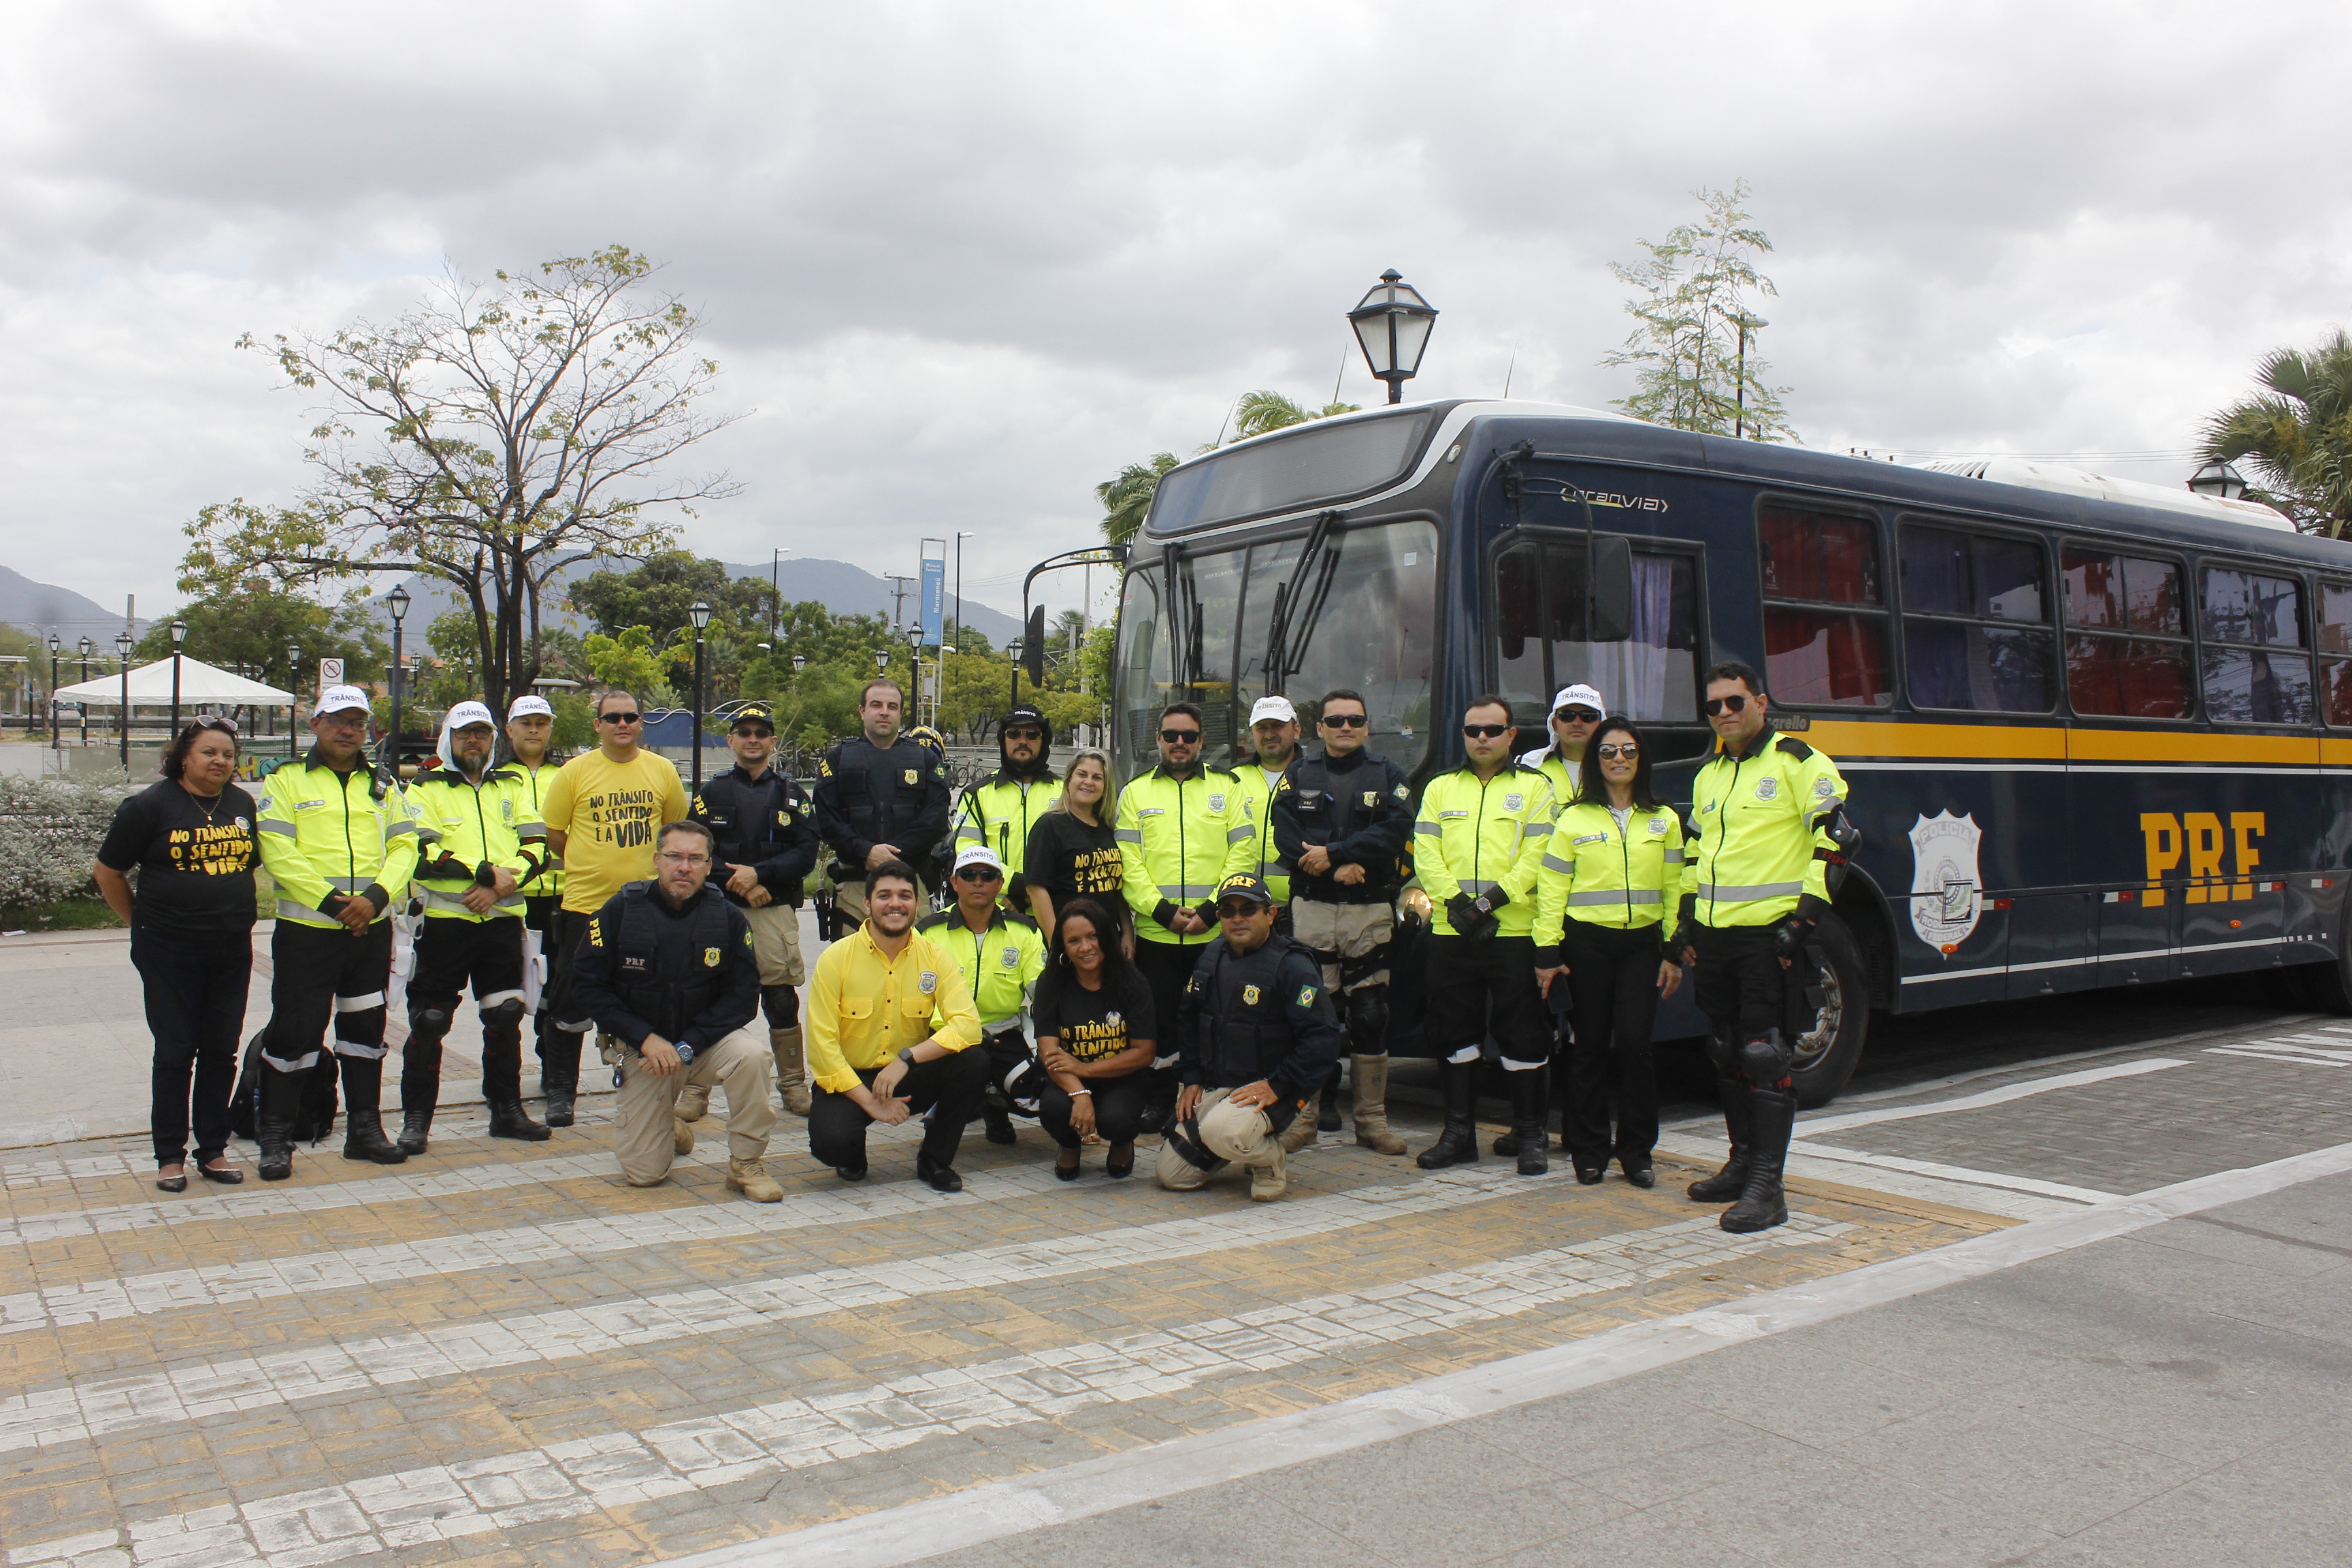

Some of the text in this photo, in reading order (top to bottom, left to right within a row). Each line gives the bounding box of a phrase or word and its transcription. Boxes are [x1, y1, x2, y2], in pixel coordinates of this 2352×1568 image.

[933, 577, 941, 613] Maracanaú
[331, 693, 365, 705] TRÂNSITO
[1562, 691, 1595, 702] TRÂNSITO
[457, 708, 489, 720] TRÂNSITO
[521, 703, 551, 713] TRÂNSITO
[738, 708, 766, 719] PRF
[1014, 709, 1036, 717] TRÂNSITO
[1767, 715, 1807, 730] arello
[918, 738, 932, 747] RF
[819, 758, 833, 777] PRF
[590, 788, 655, 808] NO TRÂNSITO,
[693, 794, 708, 815] PRF
[592, 806, 653, 822] O SENTIDO
[169, 830, 190, 843] NO
[596, 818, 653, 848] É A VIDA
[171, 839, 253, 860] O SENTIDO
[962, 851, 994, 862] TRÂNSITO
[1075, 853, 1090, 868] NO
[1822, 849, 1847, 866] Tige
[2140, 812, 2266, 907] PRF
[1075, 871, 1083, 881] O
[1221, 875, 1257, 891] PRF
[589, 917, 604, 947] PRF
[1927, 930, 1964, 941] FEDERAL
[625, 957, 645, 966] PRF
[1073, 1036, 1127, 1056] SENTIDO
